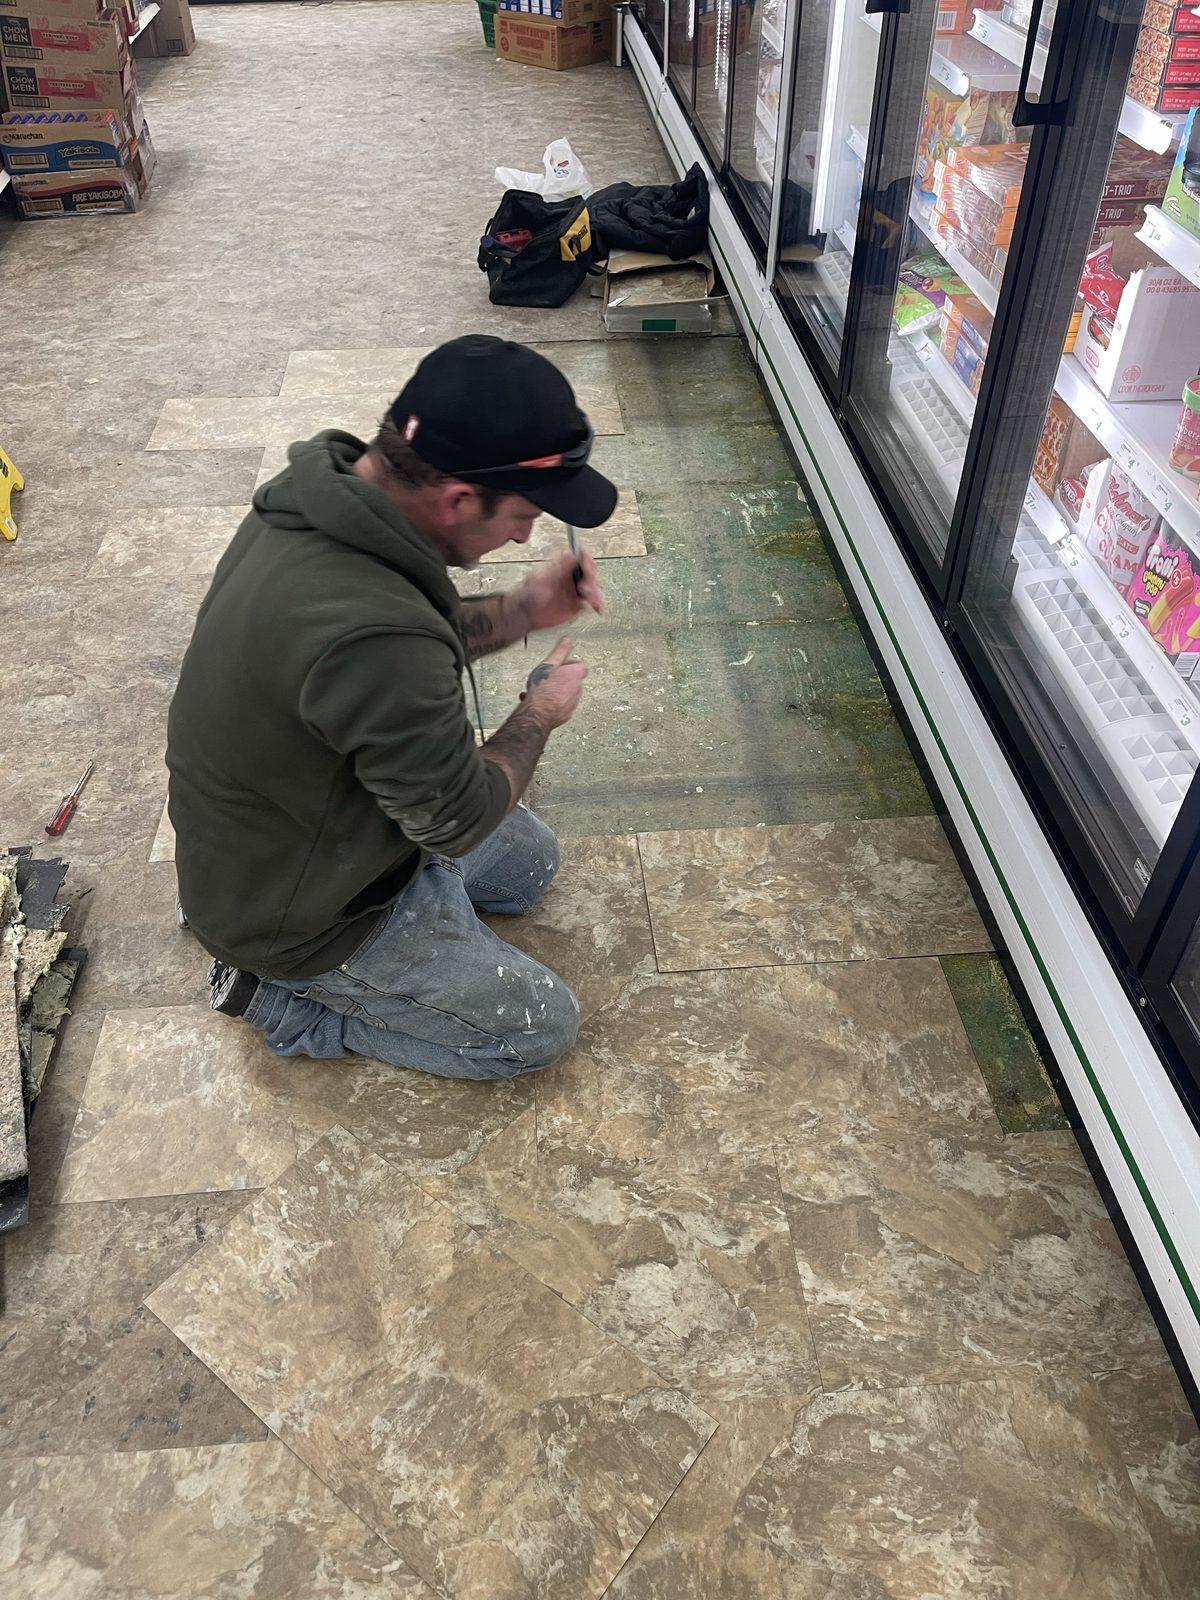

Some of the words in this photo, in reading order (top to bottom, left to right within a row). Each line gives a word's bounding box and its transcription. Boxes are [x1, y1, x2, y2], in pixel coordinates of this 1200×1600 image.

[2, 25, 27, 34] CHOW
[4, 34, 29, 43] MEIN
[11, 76, 35, 84] CHOW
[12, 84, 36, 92] MEIN
[9, 132, 44, 141] Maruchan
[60, 146, 100, 157] Yakisoba
[72, 191, 87, 203] FIRE
[88, 189, 124, 202] YAKISOBA
[1146, 545, 1179, 579] Trolli
